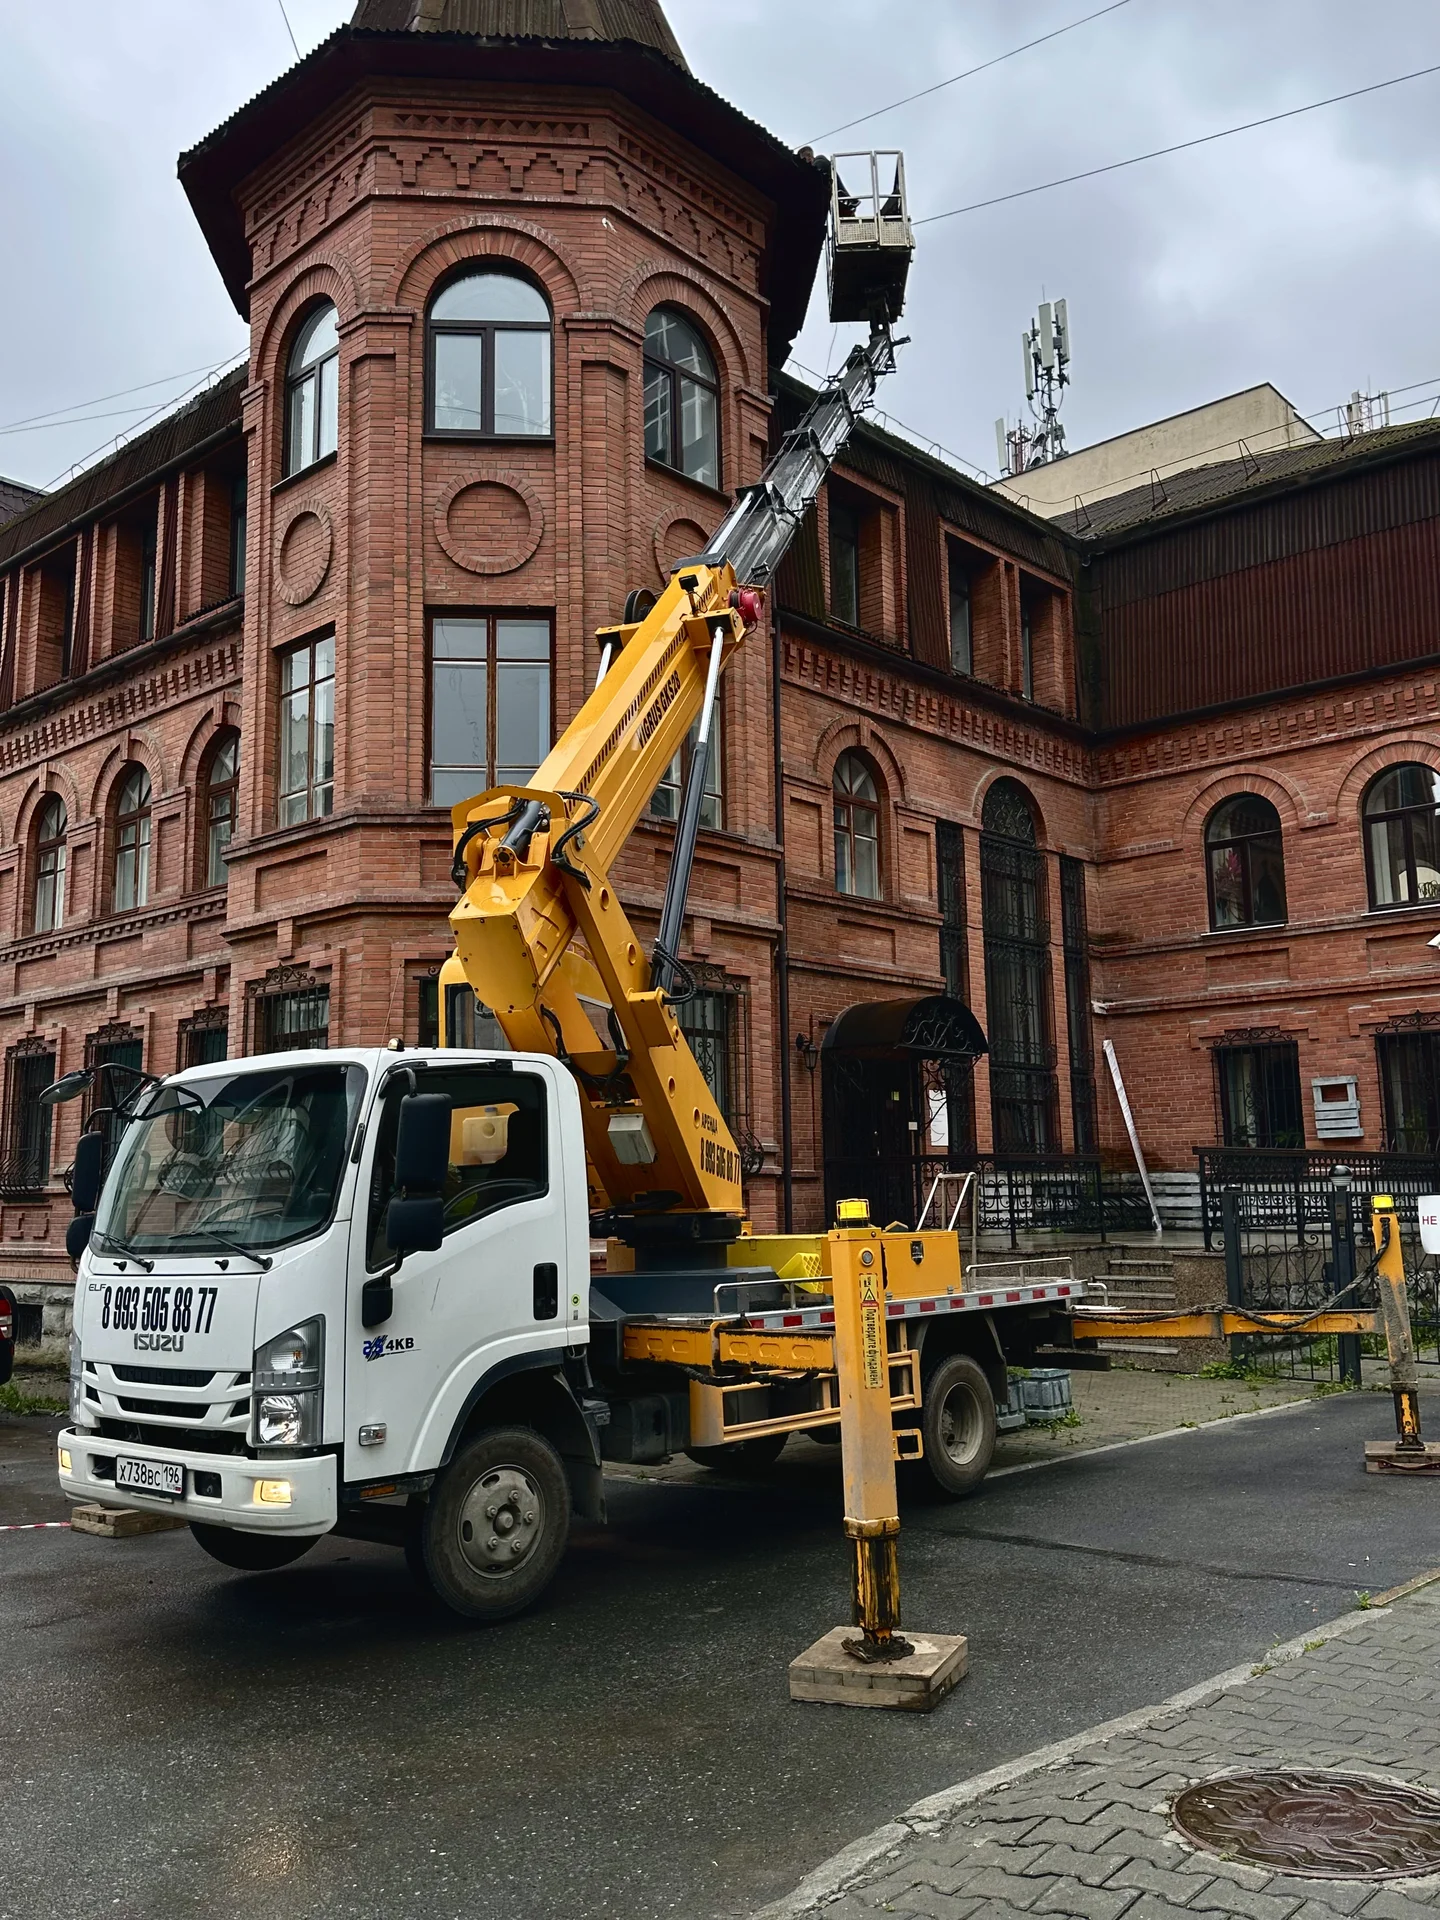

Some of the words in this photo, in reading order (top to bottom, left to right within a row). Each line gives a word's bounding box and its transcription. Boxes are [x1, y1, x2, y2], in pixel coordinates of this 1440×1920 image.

[636, 701, 663, 749] VIGRUS
[660, 670, 681, 712] GKS28
[702, 1113, 718, 1135] АРЕНДА
[701, 1137, 704, 1170] 8
[705, 1139, 715, 1175] 993
[716, 1144, 726, 1179] 505
[726, 1149, 733, 1183] 88
[734, 1153, 740, 1185] 77
[1422, 1215, 1438, 1225] НЕ
[88, 1283, 106, 1292] ELF
[102, 1286, 112, 1329] 8
[113, 1285, 141, 1331] 993
[141, 1286, 171, 1332] 505
[172, 1286, 193, 1333] 88
[194, 1287, 218, 1334] 77
[865, 1309, 876, 1348] Подтвердите
[133, 1332, 184, 1352] ISUZU
[386, 1338, 414, 1350] 4KB
[164, 1466, 179, 1483] 196
